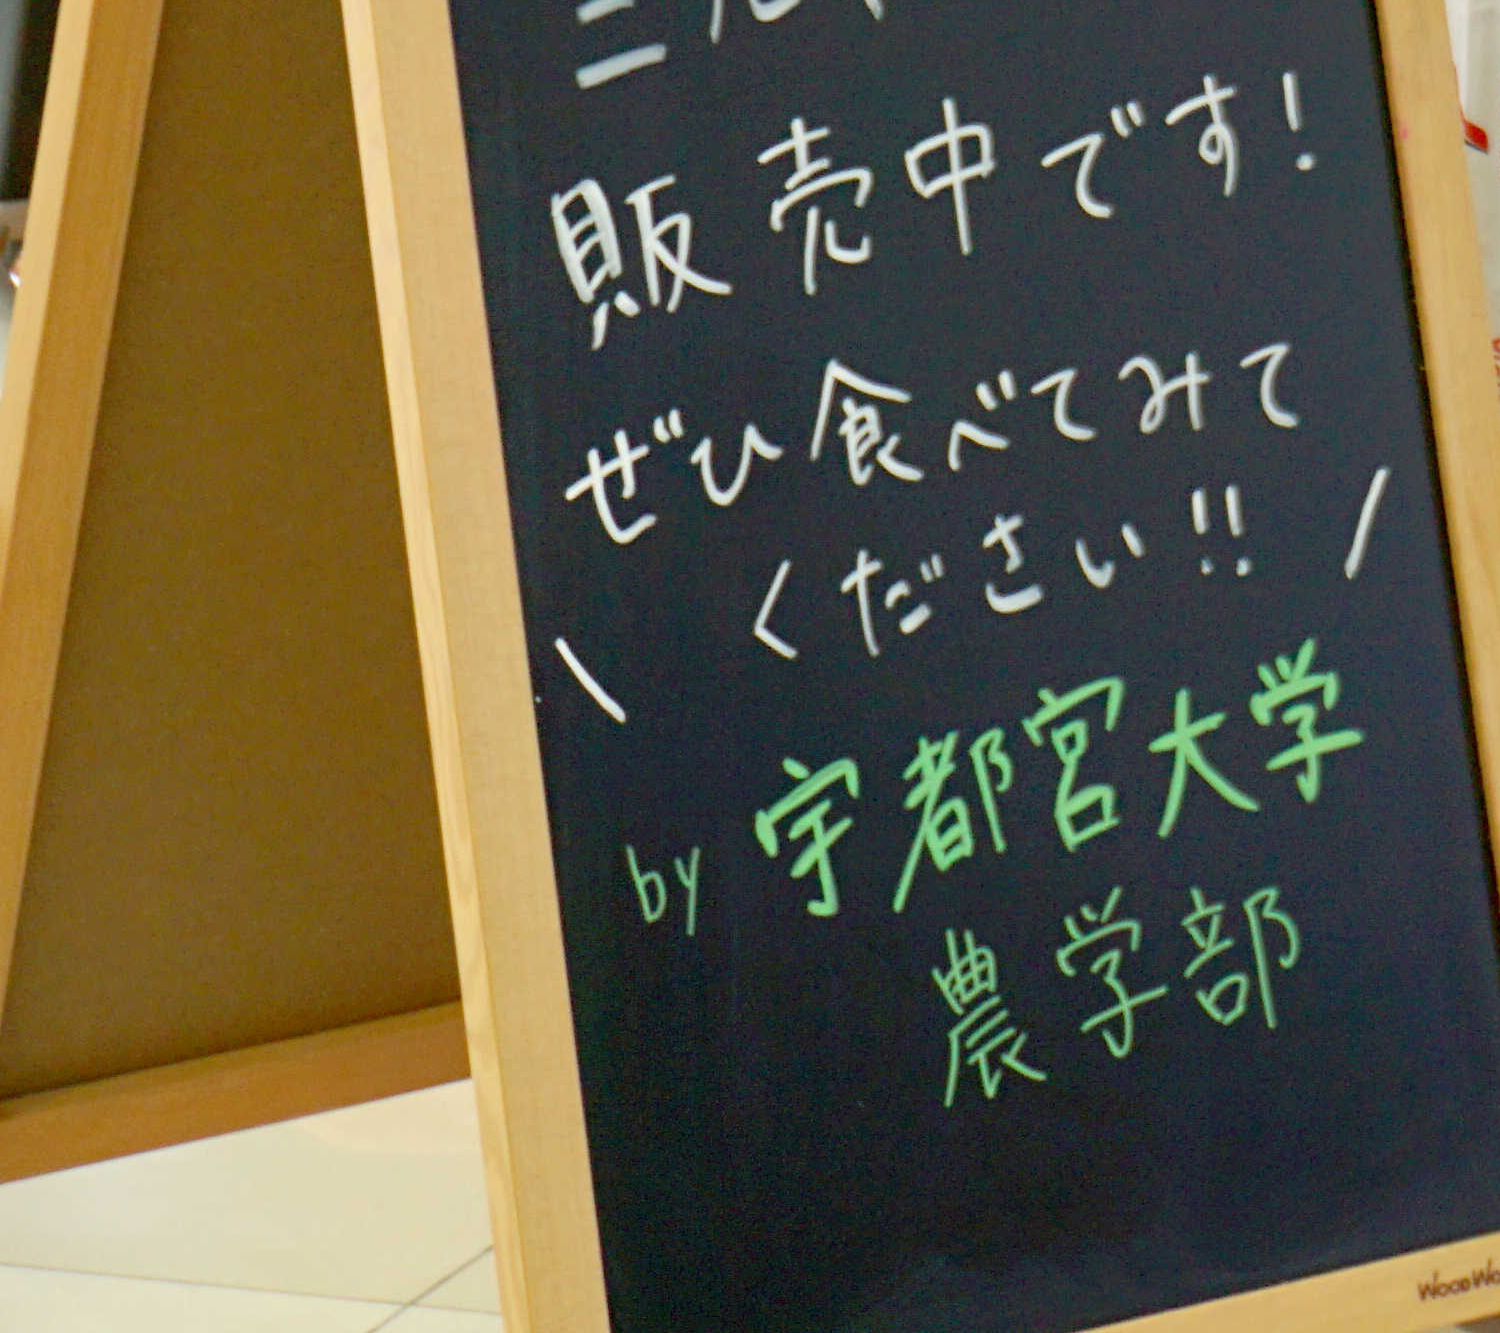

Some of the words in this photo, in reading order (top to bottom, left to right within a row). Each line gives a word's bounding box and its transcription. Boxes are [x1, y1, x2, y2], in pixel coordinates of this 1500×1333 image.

[550, 69, 1318, 351] 販売中です!
[562, 341, 1302, 545] ぜひ食べてみて
[752, 485, 1254, 660] ください!!
[622, 842, 705, 939] by
[751, 636, 1368, 917] 宇都宮大学
[933, 884, 1304, 1110] 農学部
